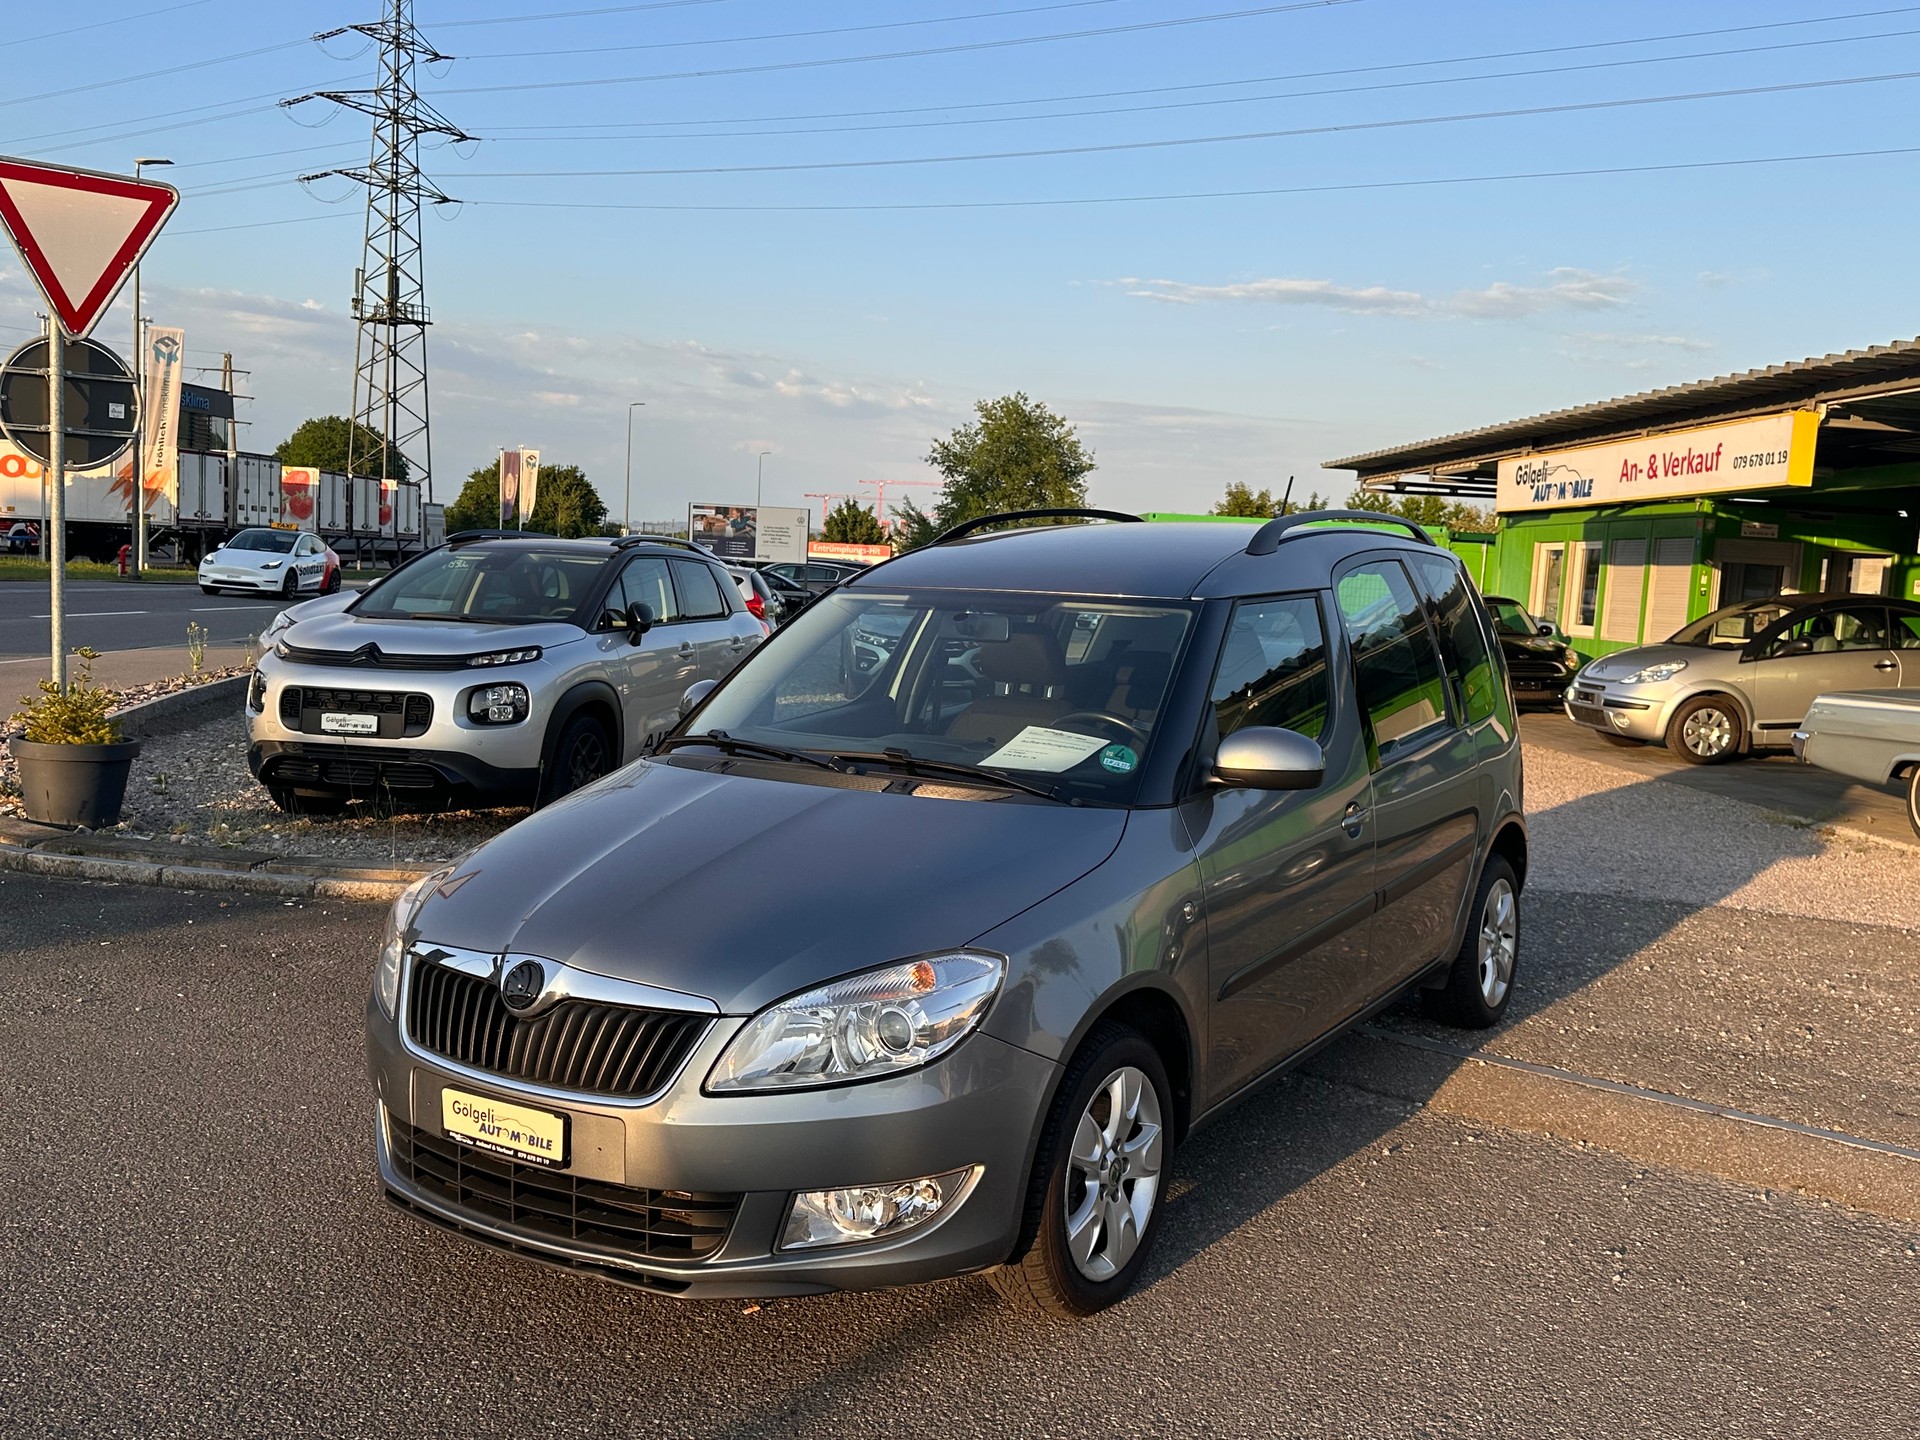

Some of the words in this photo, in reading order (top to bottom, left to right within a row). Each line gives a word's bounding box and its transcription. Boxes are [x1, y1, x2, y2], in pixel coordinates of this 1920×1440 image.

[1515, 460, 1549, 490] Gölgeli
[1619, 458, 1644, 483] An-
[1646, 454, 1659, 480] &
[1662, 442, 1723, 478] Verkauf
[1733, 455, 1748, 470] 079
[1749, 453, 1764, 468] 678
[1765, 452, 1776, 466] 01
[1777, 450, 1788, 464] 19
[1532, 478, 1594, 502] AUTOMOBILE
[1114, 747, 1126, 760] 4
[452, 1100, 495, 1124] Gölgeli
[478, 1122, 553, 1151] AUTOMOBILE
